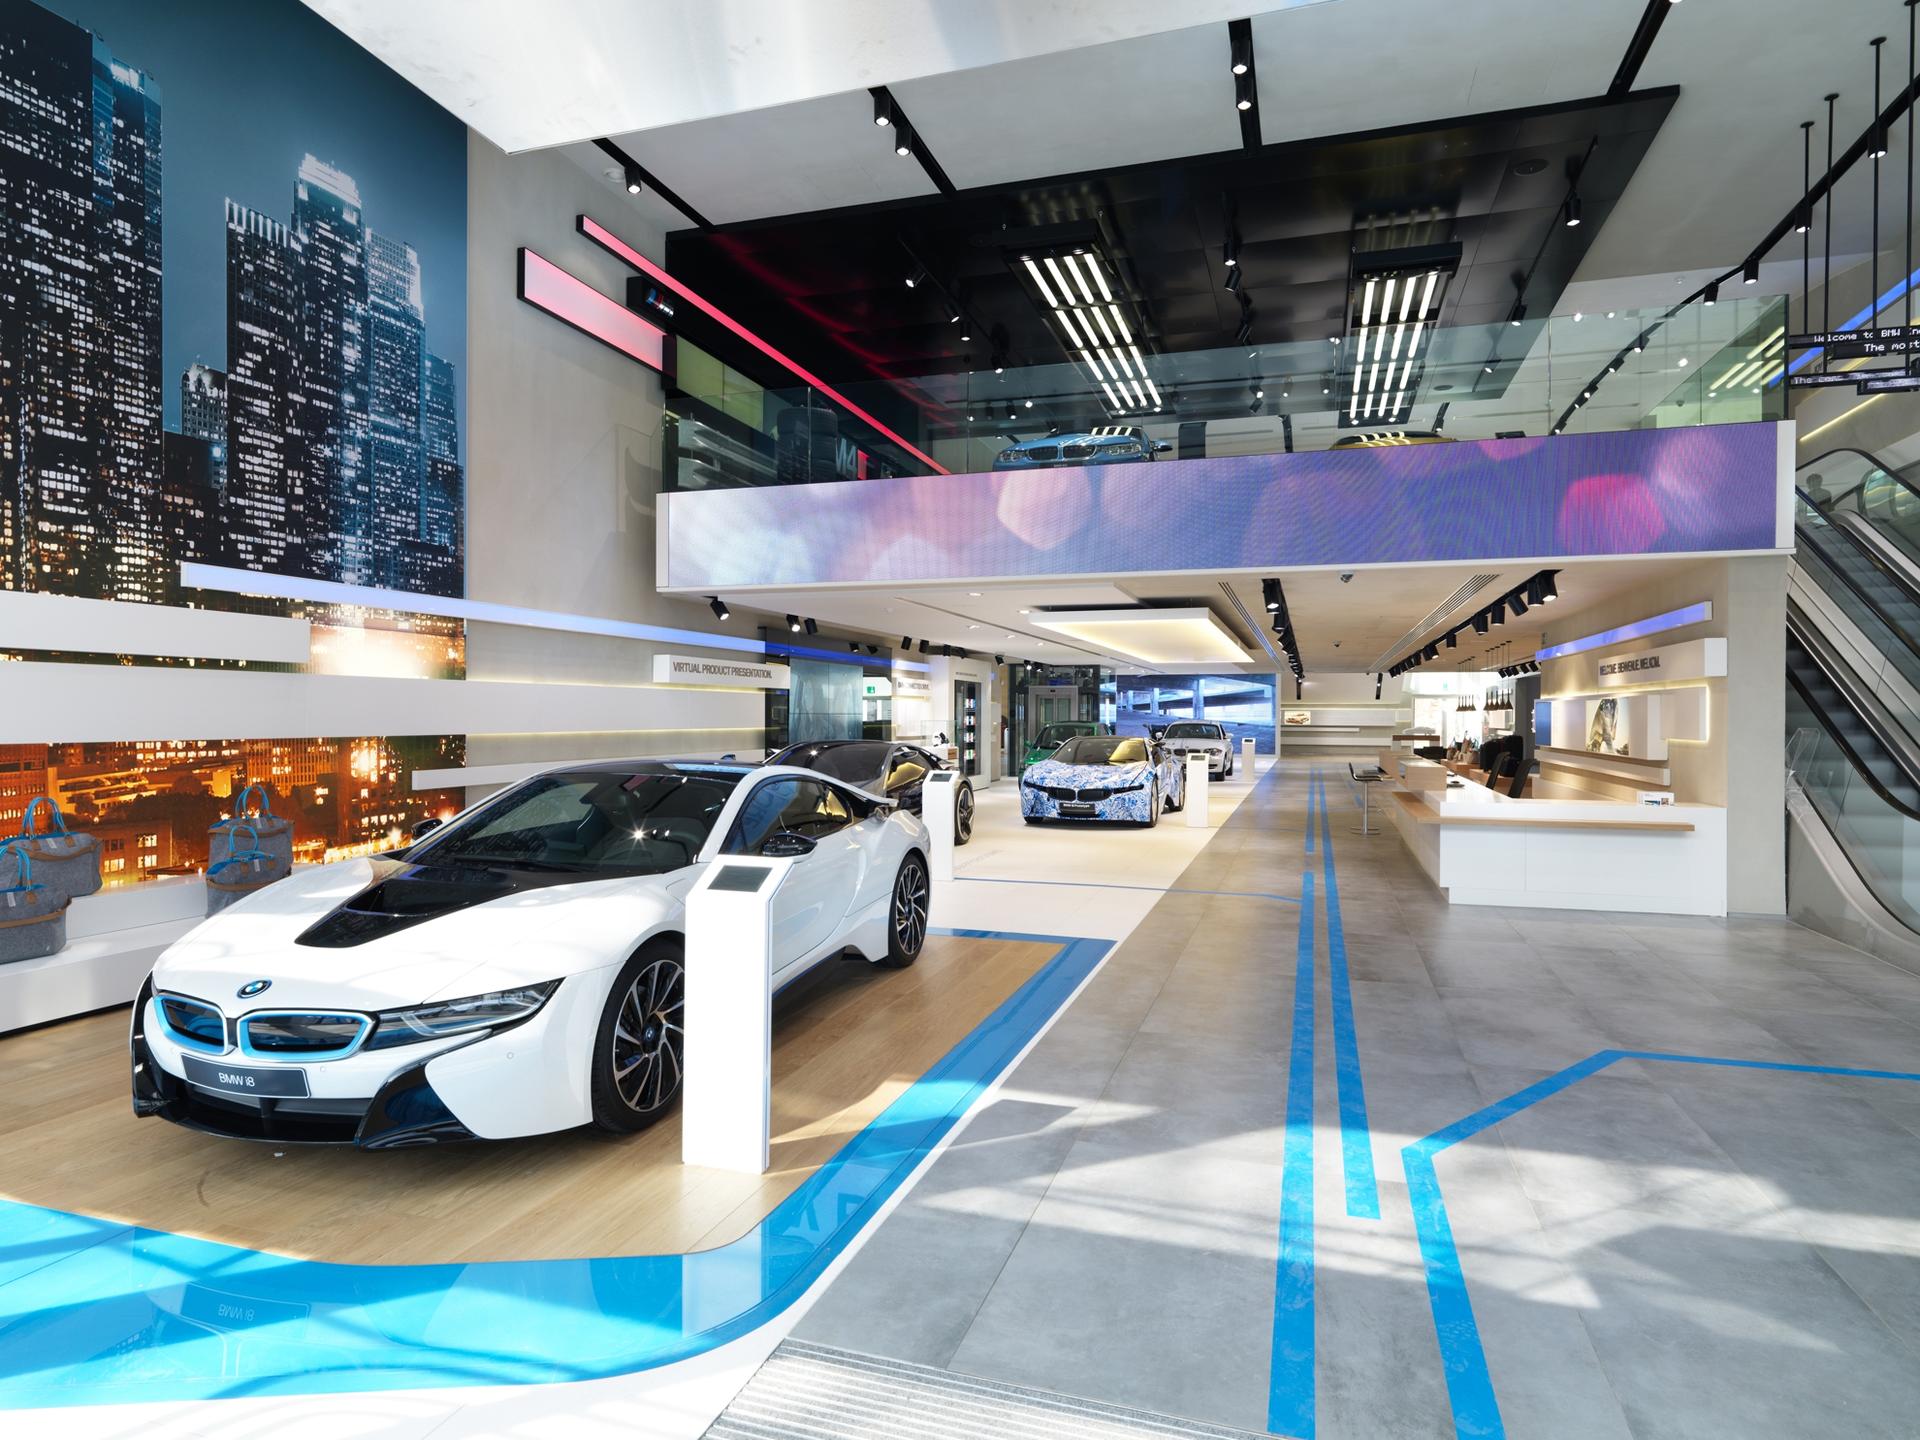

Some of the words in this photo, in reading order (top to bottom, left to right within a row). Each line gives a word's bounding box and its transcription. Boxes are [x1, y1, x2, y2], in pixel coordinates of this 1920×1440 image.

[1814, 334, 1857, 343] Welcome
[1881, 328, 1900, 338] BMW
[1864, 343, 1885, 352] The
[673, 661, 701, 673] VIRTUAL
[702, 664, 731, 676] PRODUCT
[218, 1072, 244, 1086] BMW
[245, 1076, 256, 1087] i8
